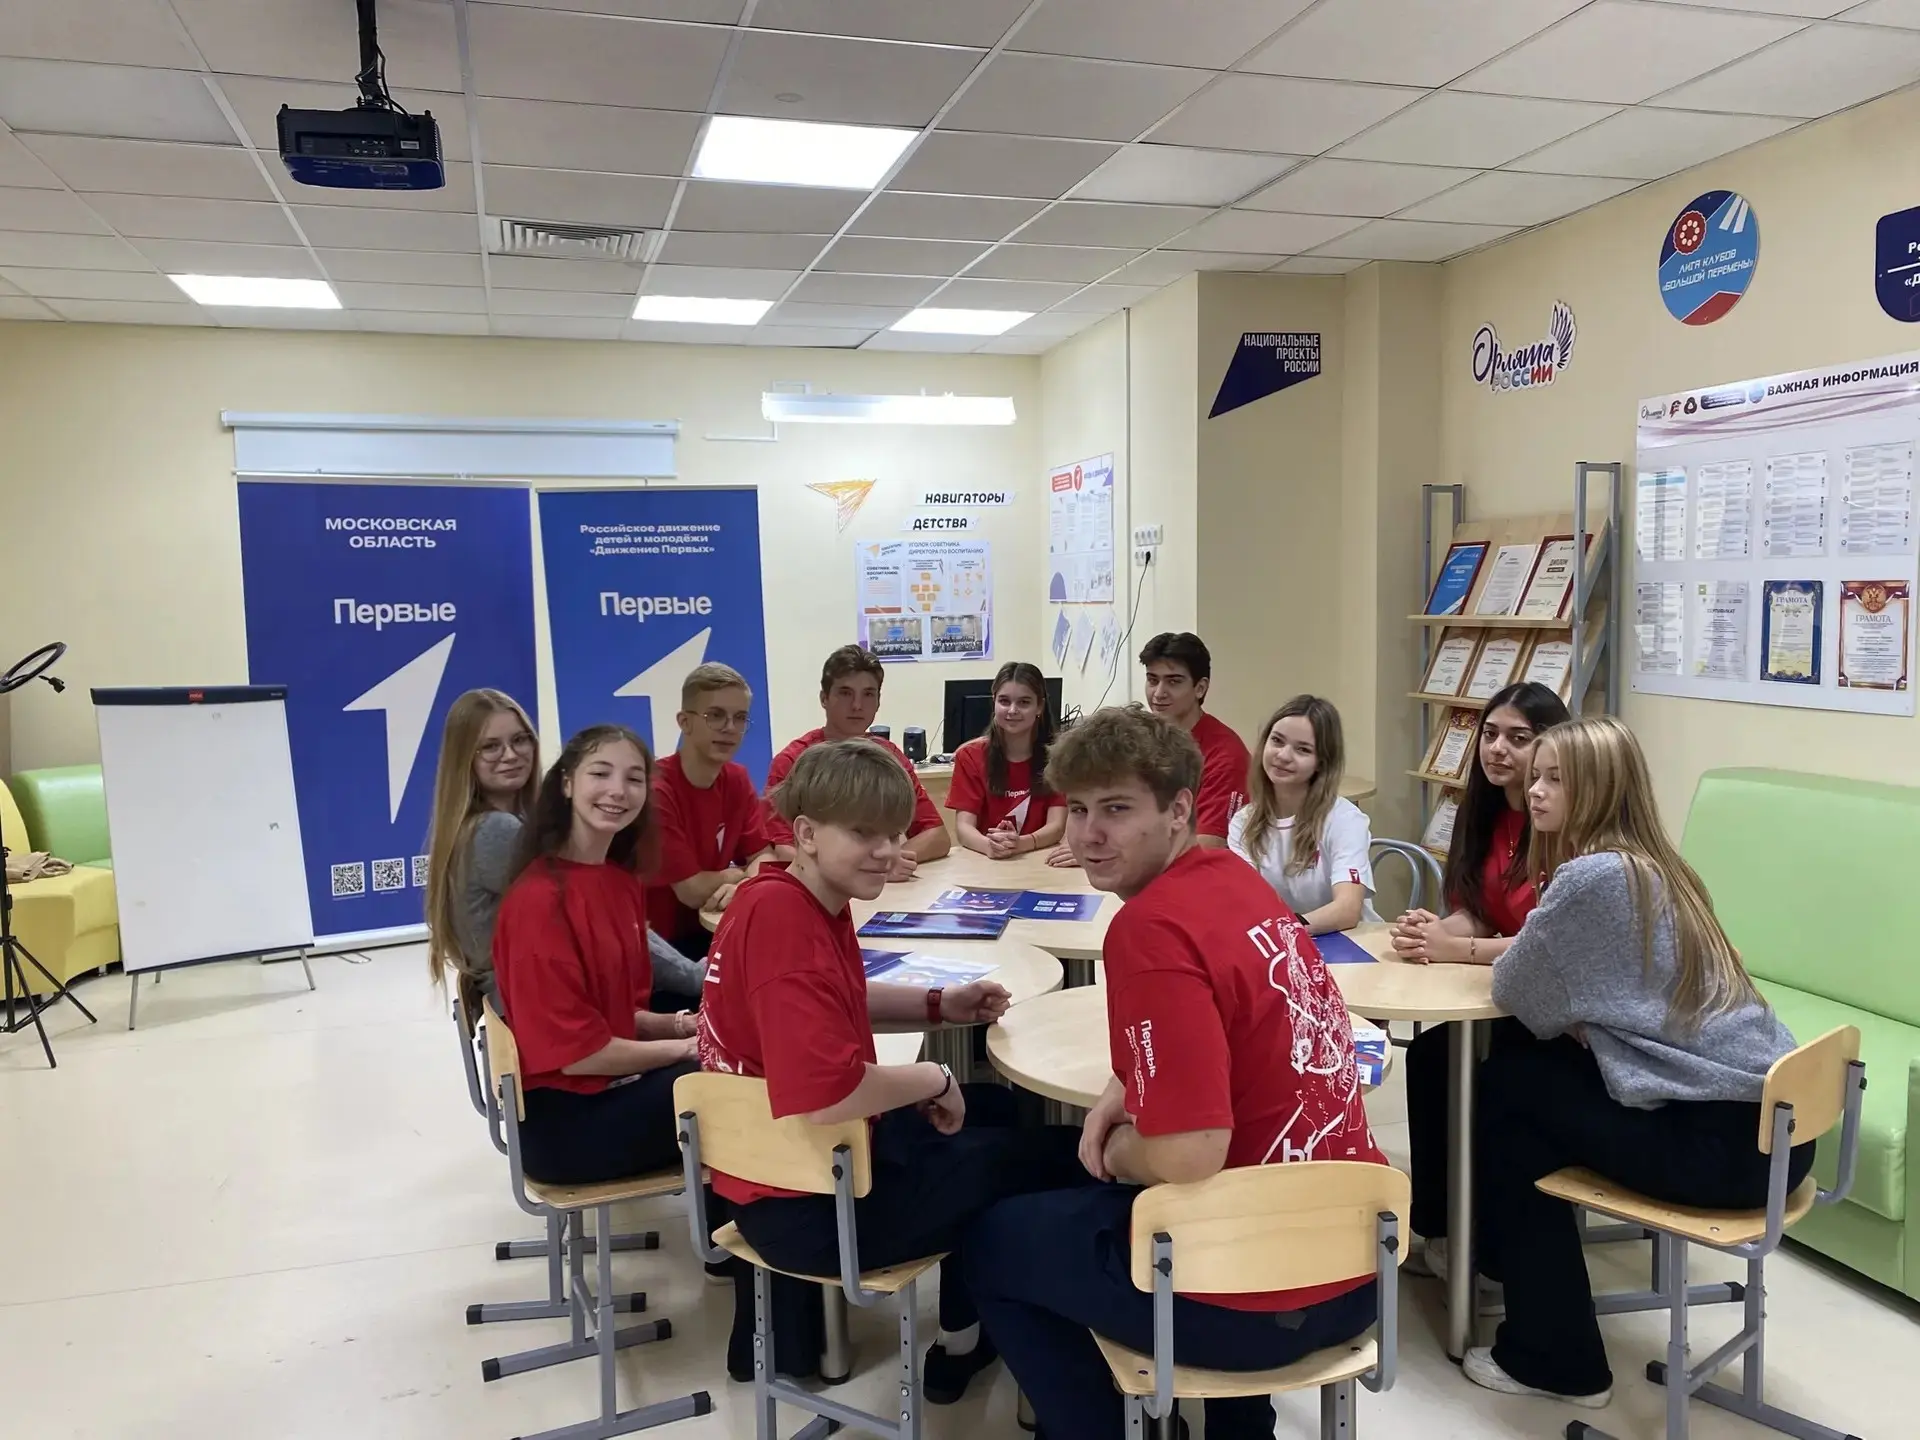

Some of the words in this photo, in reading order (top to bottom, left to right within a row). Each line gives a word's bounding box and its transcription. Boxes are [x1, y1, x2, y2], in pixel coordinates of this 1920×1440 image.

[1678, 260, 1701, 274] ЛИГА
[1702, 249, 1737, 266] КЛУБОВ
[1662, 270, 1705, 291] «БОЛЬШОЙ
[1707, 258, 1754, 279] ПЕРЕМЕНЫ»
[1244, 334, 1319, 348] НАЦИОНАЛЬНЫЕ
[1276, 348, 1319, 360] ПРОЕКТЫ
[1473, 327, 1554, 385] Орлята
[1284, 360, 1319, 372] РОССИИ
[1491, 364, 1553, 391] РОССИИ
[1767, 378, 1819, 396] ВАЖНАЯ
[1822, 361, 1920, 387] ИНФОРМАЦИЯ
[925, 493, 1005, 504] НАВИГАТОРЫ
[325, 518, 457, 531] МОСКОВСКАЯ
[580, 524, 655, 534] Российское
[657, 524, 721, 533] движение
[912, 518, 968, 530] ДЕТСТВА
[349, 536, 437, 548] ОБЛАСТЬ
[595, 535, 632, 545] детей
[644, 534, 709, 544] молодёжи
[589, 546, 660, 556] «Движение
[661, 545, 715, 555] Первых»
[1776, 596, 1808, 604] ГРАМОТА
[600, 592, 713, 623] Первые
[334, 598, 457, 631] Первые
[1855, 614, 1892, 623] ГРАМОТА
[1141, 1020, 1156, 1078] Первые
